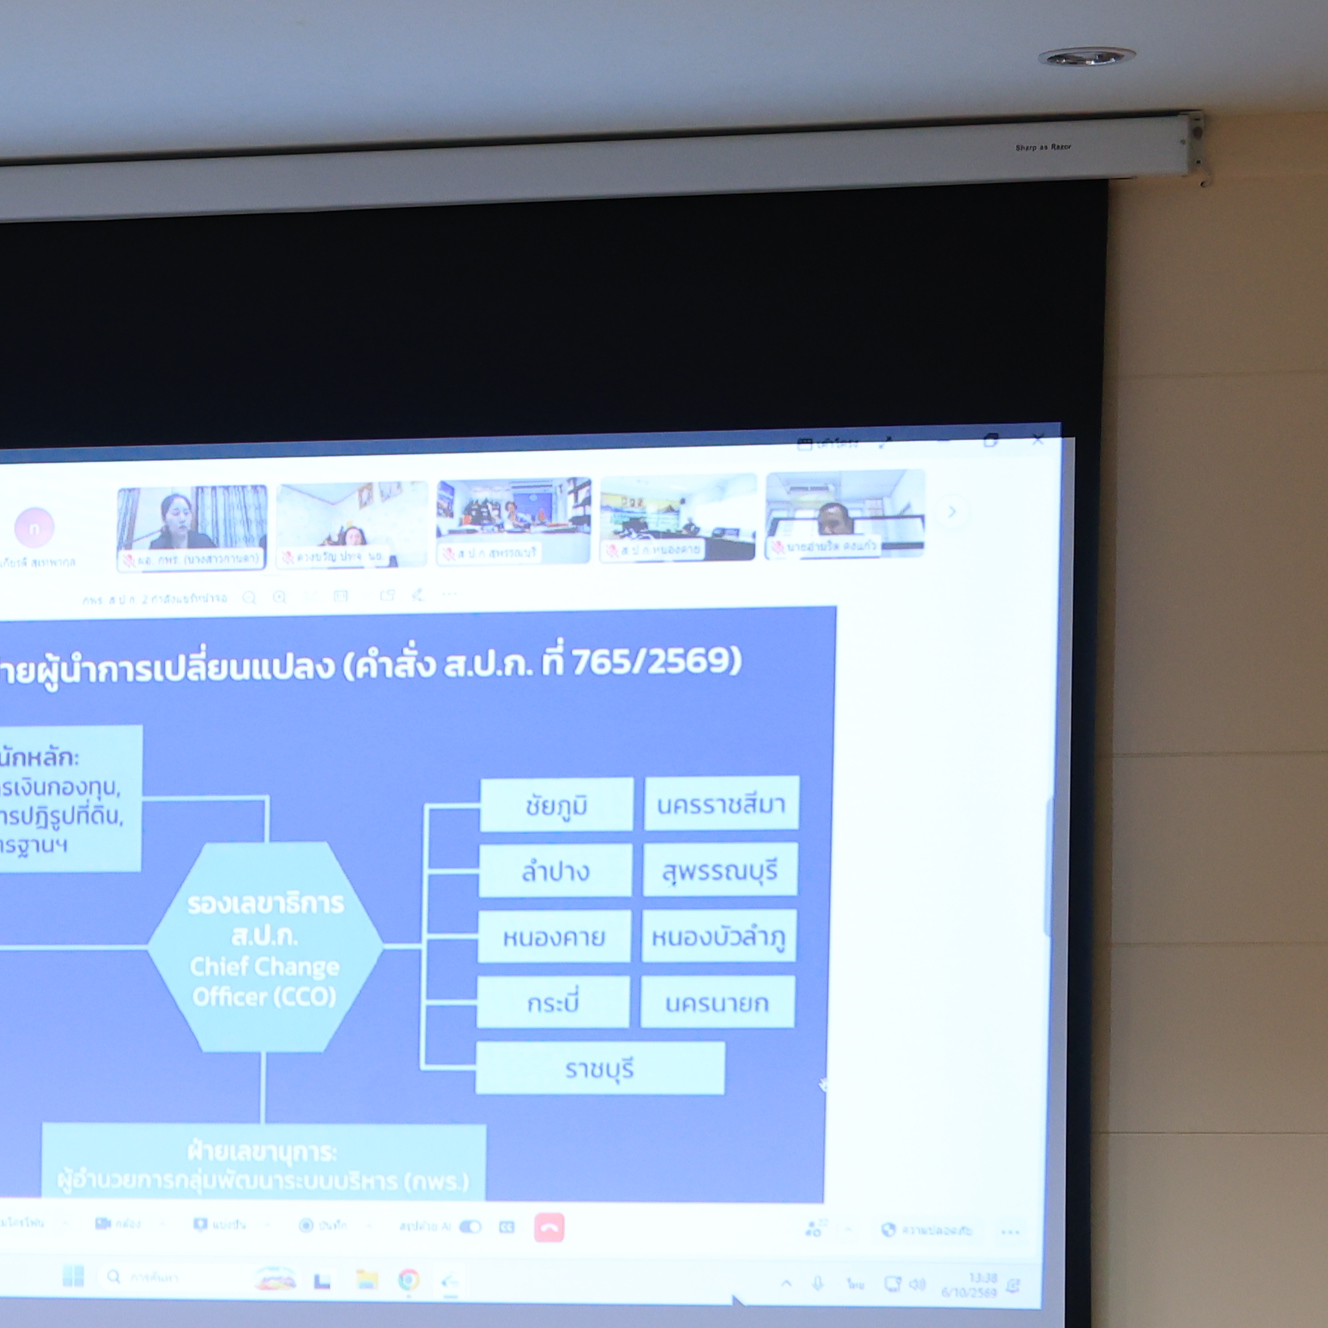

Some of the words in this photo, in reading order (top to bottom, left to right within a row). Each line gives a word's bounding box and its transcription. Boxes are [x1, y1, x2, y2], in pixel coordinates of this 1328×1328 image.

[343, 640, 437, 682] (คำสั่ง
[443, 648, 534, 679] ส.ป.ก.
[542, 637, 566, 677] ที่
[572, 645, 743, 678] 765/2569)
[525, 792, 589, 824] ชัยภูมิ
[656, 789, 787, 817] นครราชสีมา
[521, 857, 591, 884] ลำปาง
[661, 855, 780, 889] สุพรรณบุรี
[187, 890, 345, 916] รองเลขาธิการ
[230, 924, 299, 947] ส.ป.ก.
[502, 927, 607, 949] หนองคาย
[651, 922, 787, 955] หนองบัวลำภู
[189, 955, 250, 978] Chief
[254, 955, 340, 982] Change
[192, 984, 268, 1008] Officer
[273, 985, 338, 1010] (CCO)
[527, 983, 581, 1014] กระบี่
[664, 993, 771, 1015] นครนายก
[564, 1054, 635, 1086] ราชบุรี
[187, 1137, 338, 1169] ฝ่ายเลขานุการ:
[56, 1166, 399, 1197] ผู้อำนวยการกลุ่มพัฒนาระบบบริหาร
[404, 1173, 470, 1195] (กพร.)
